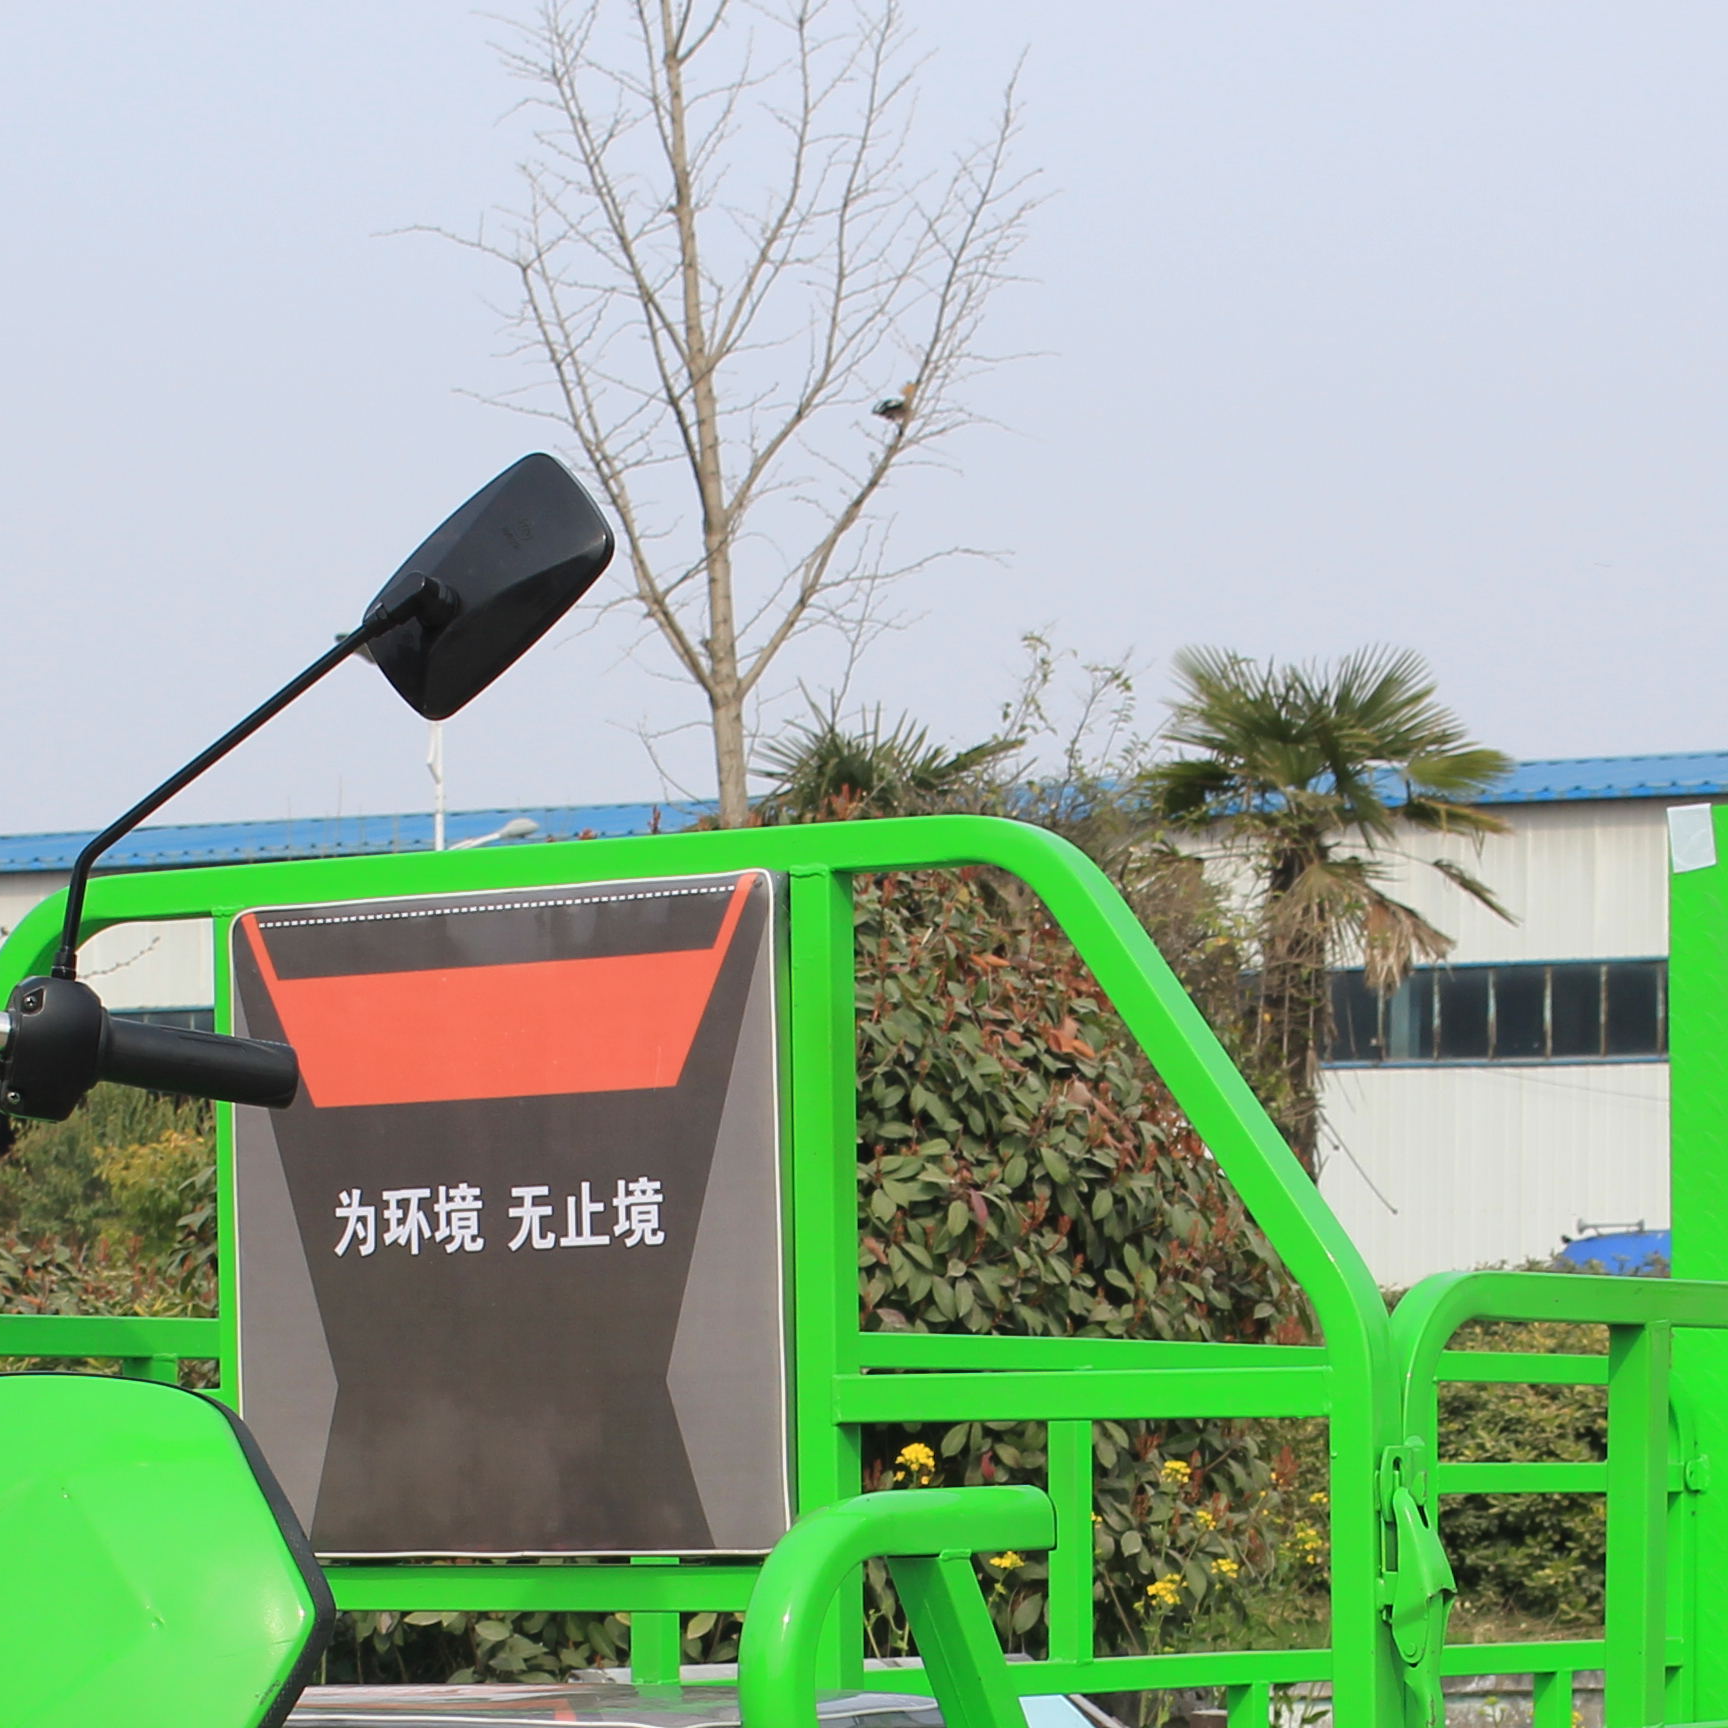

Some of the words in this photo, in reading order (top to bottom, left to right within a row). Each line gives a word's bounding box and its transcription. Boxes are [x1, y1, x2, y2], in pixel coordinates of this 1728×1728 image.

[333, 1181, 485, 1258] 为环境
[507, 1175, 666, 1253] 无止境
